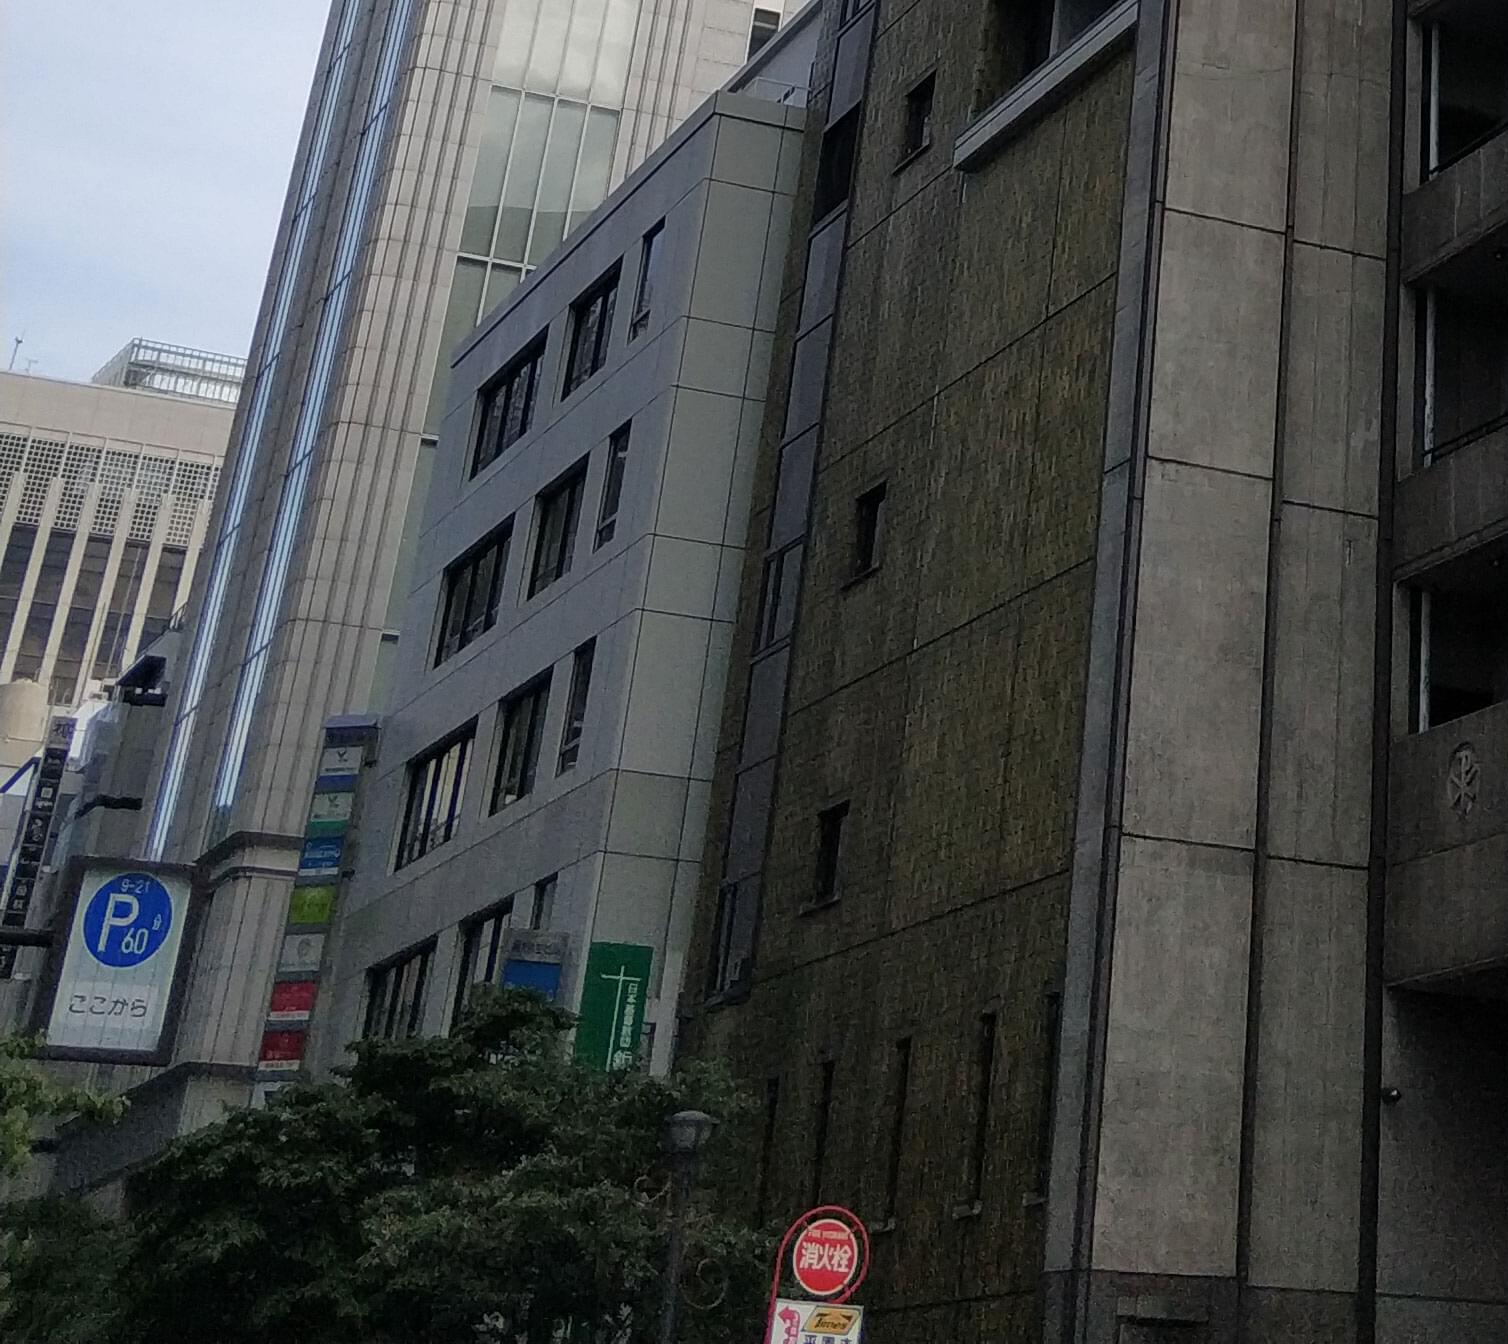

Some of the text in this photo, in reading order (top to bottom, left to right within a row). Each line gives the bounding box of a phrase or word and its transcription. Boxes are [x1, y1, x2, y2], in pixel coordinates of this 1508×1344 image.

[97, 892, 140, 953] P
[68, 993, 148, 1018] ここから
[800, 1242, 852, 1272] 消火栓
